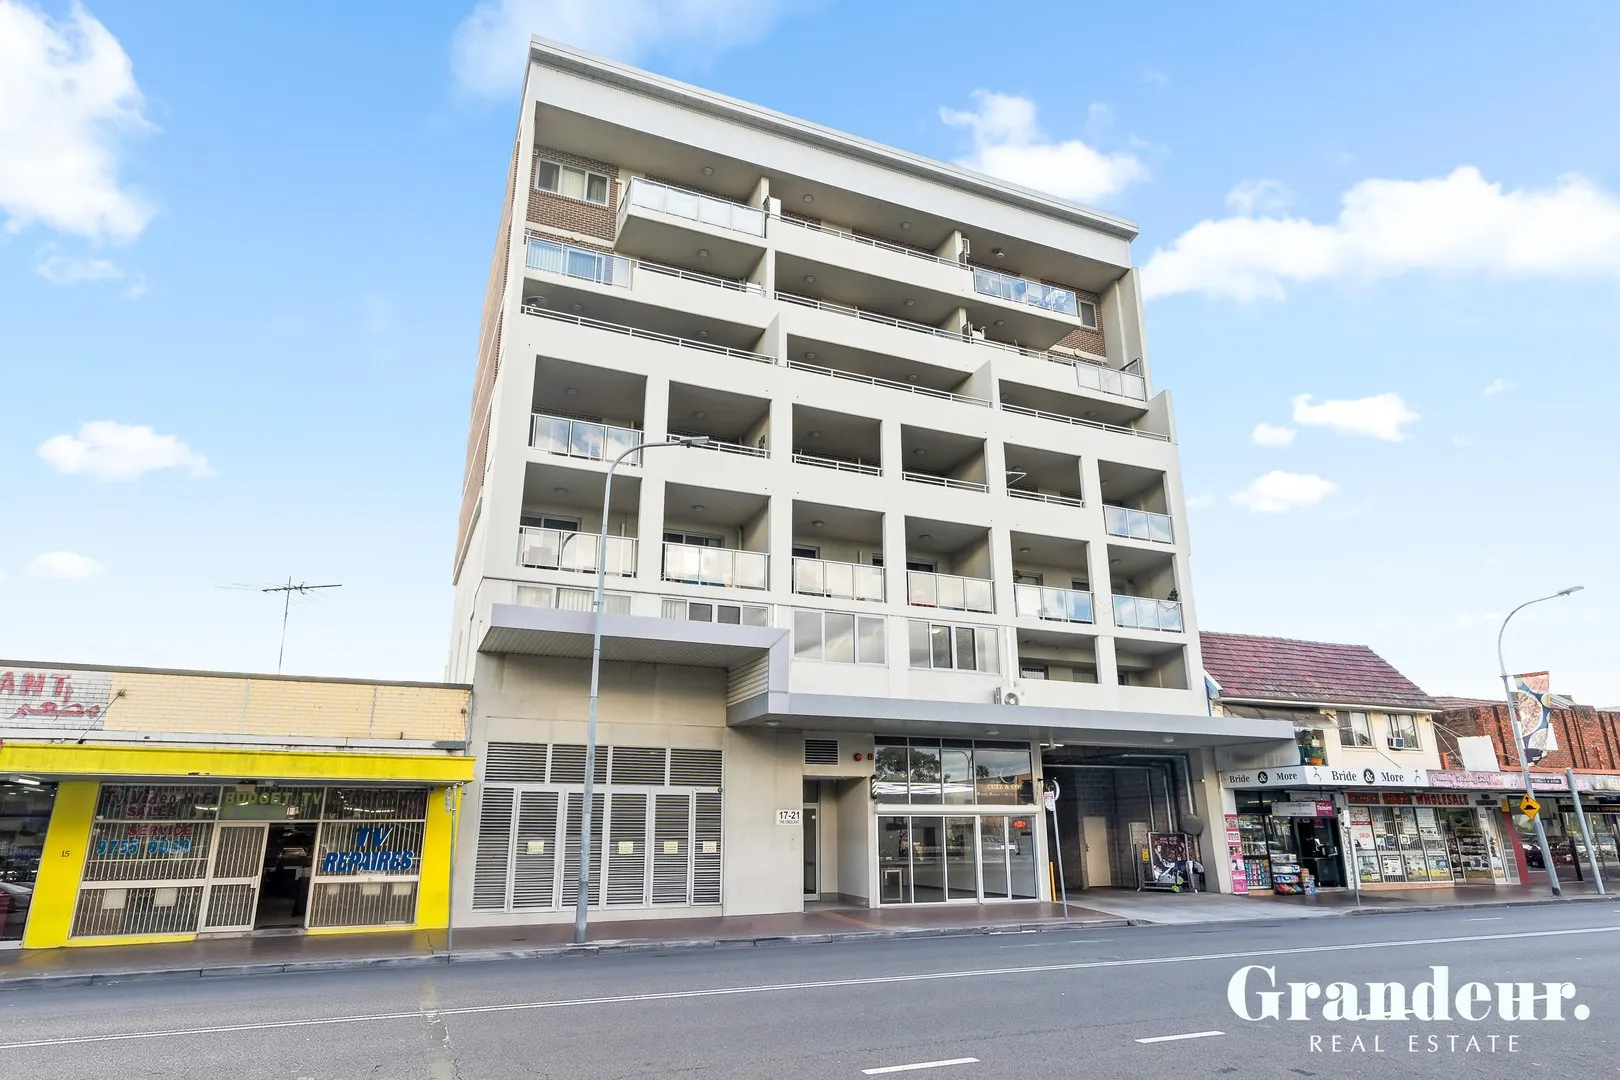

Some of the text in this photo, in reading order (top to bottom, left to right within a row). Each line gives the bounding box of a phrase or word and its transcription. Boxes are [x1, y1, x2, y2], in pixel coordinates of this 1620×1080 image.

[1229, 772, 1297, 783] Bride & More
[1331, 769, 1404, 783] Bride & More
[225, 791, 293, 804] BUDGET
[301, 792, 323, 805] TV
[1415, 794, 1469, 805] WHOLESALE
[779, 811, 800, 820] 17-21
[128, 824, 193, 836] SERVICE
[356, 827, 393, 847] TV
[97, 839, 139, 855] 9755
[323, 850, 415, 872] REPAIRES
